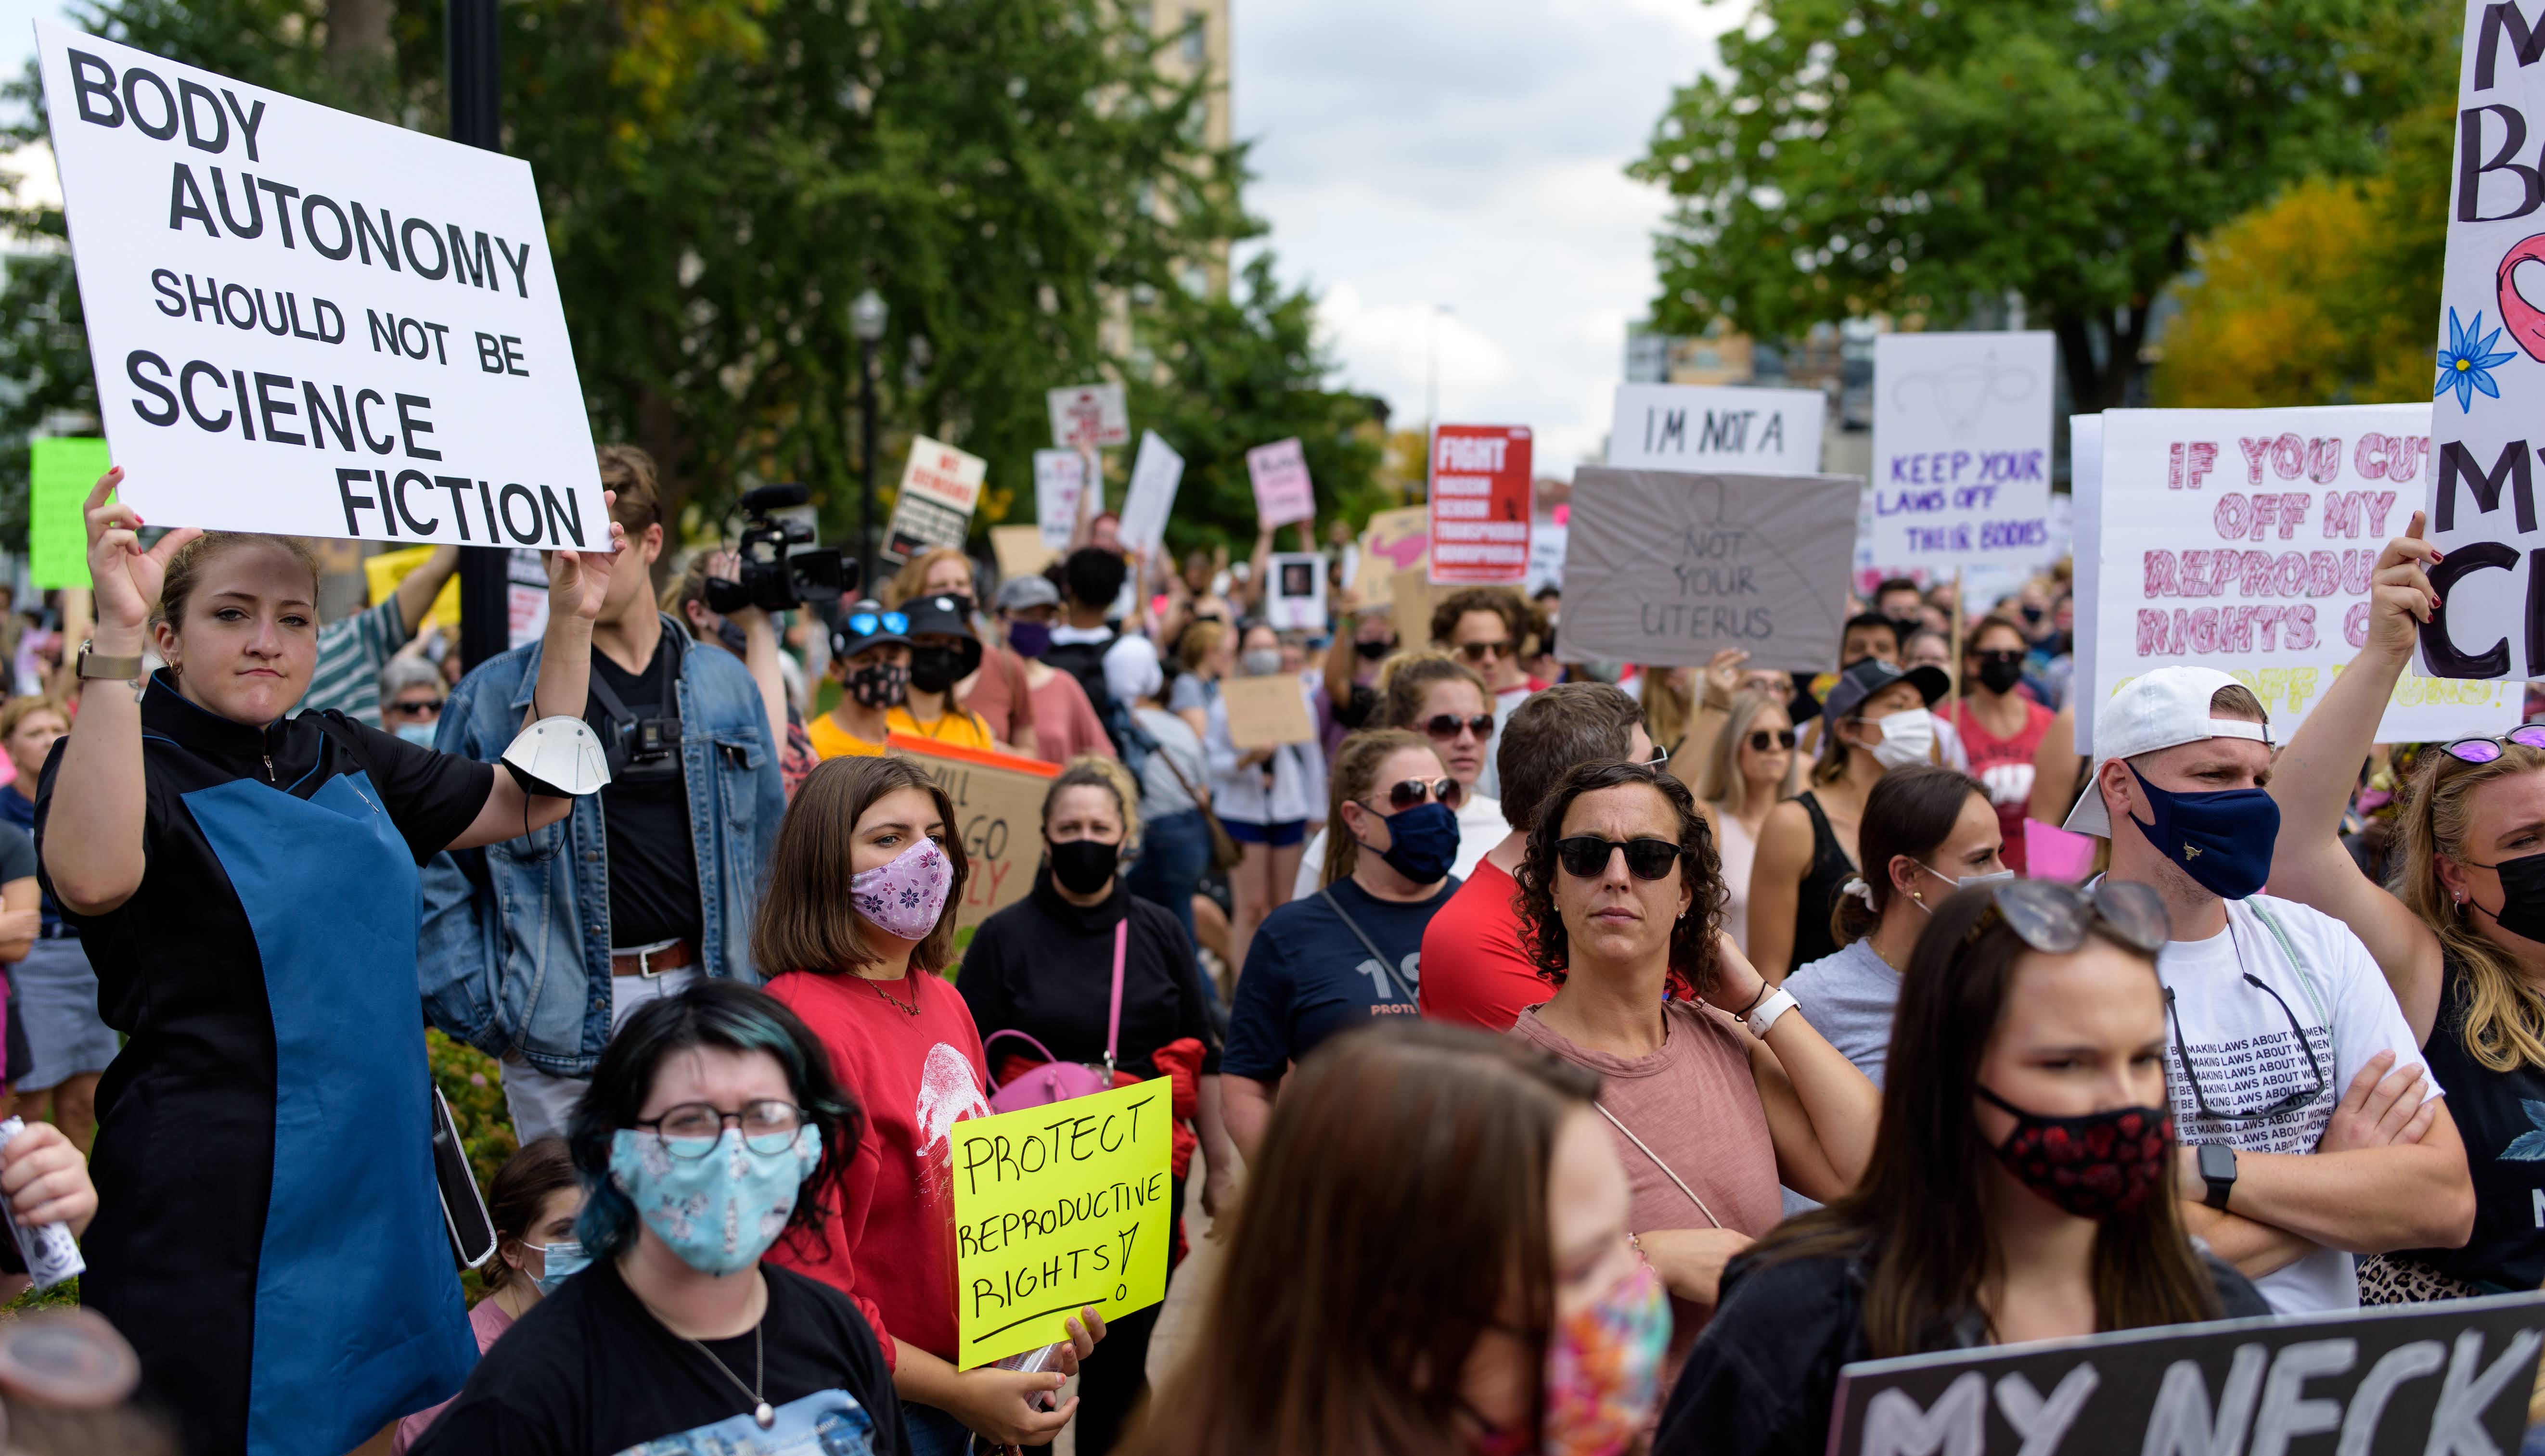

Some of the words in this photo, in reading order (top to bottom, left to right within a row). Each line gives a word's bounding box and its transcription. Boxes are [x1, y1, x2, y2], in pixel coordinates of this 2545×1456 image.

[67, 47, 266, 163] BODY
[169, 162, 530, 298] AUTONOMY
[151, 268, 345, 345] SHOULD
[367, 308, 449, 365] NOT
[475, 331, 529, 377] BE
[126, 349, 442, 461] SCIENCE
[1698, 408, 1757, 453] NOT
[1757, 409, 1784, 453] A
[1439, 436, 1508, 473] FIGHT
[1891, 449, 1972, 484] KEEP
[1979, 448, 2044, 481] YOUR
[2169, 441, 2218, 489] IF
[2238, 432, 2341, 485] YOU
[1876, 487, 1945, 517] LAWS
[1954, 485, 1997, 511] OFF
[2435, 440, 2545, 534] M
[335, 468, 585, 548] FICTION
[2213, 492, 2311, 542] OFF
[2323, 491, 2396, 538] MY
[1683, 530, 1748, 560] NOT
[1906, 522, 1971, 551] THEIR
[1980, 518, 2048, 551] BODIES
[1672, 562, 1761, 597] YOUR
[1640, 602, 1774, 640] UTERUS
[2136, 604, 2321, 657] RIGHTS,
[964, 815, 1008, 860] GO
[2186, 1044, 2217, 1054] MAKING
[2218, 1040, 2249, 1053] LAWS
[2252, 1032, 2288, 1047] ABOUT
[2189, 1058, 2220, 1067] MAKING
[2221, 1053, 2252, 1066] LAWS
[2256, 1045, 2291, 1060] ABOUT
[2294, 1039, 2329, 1052] WMEN
[2179, 1086, 2193, 1095] BE
[2228, 1078, 2259, 1092] LAWS
[2263, 1071, 2299, 1086] ABOUT
[2224, 1065, 2256, 1079] LAWS
[2260, 1058, 2295, 1073] ABOUT
[2181, 1099, 2194, 1109] BE
[2231, 1092, 2262, 1106] LAWS
[2266, 1085, 2301, 1100] ABOUT
[2182, 1112, 2194, 1122] BE
[2183, 1126, 2196, 1135] BE
[2197, 1124, 2232, 1134] MAKING
[2235, 1119, 2264, 1132] LAWS
[2268, 1111, 2305, 1125] ABOUT
[2237, 1131, 2268, 1144] LAWS
[2272, 1124, 2304, 1138] ABOUT
[964, 1095, 1155, 1195] PROTECT
[2274, 1136, 2300, 1152] ABOUT
[959, 1173, 1163, 1259] REPRODUCTIVE
[973, 1222, 1140, 1318] RIGHTS!
[1860, 1361, 2101, 1456] MY
[2140, 1328, 2544, 1456] NECK
